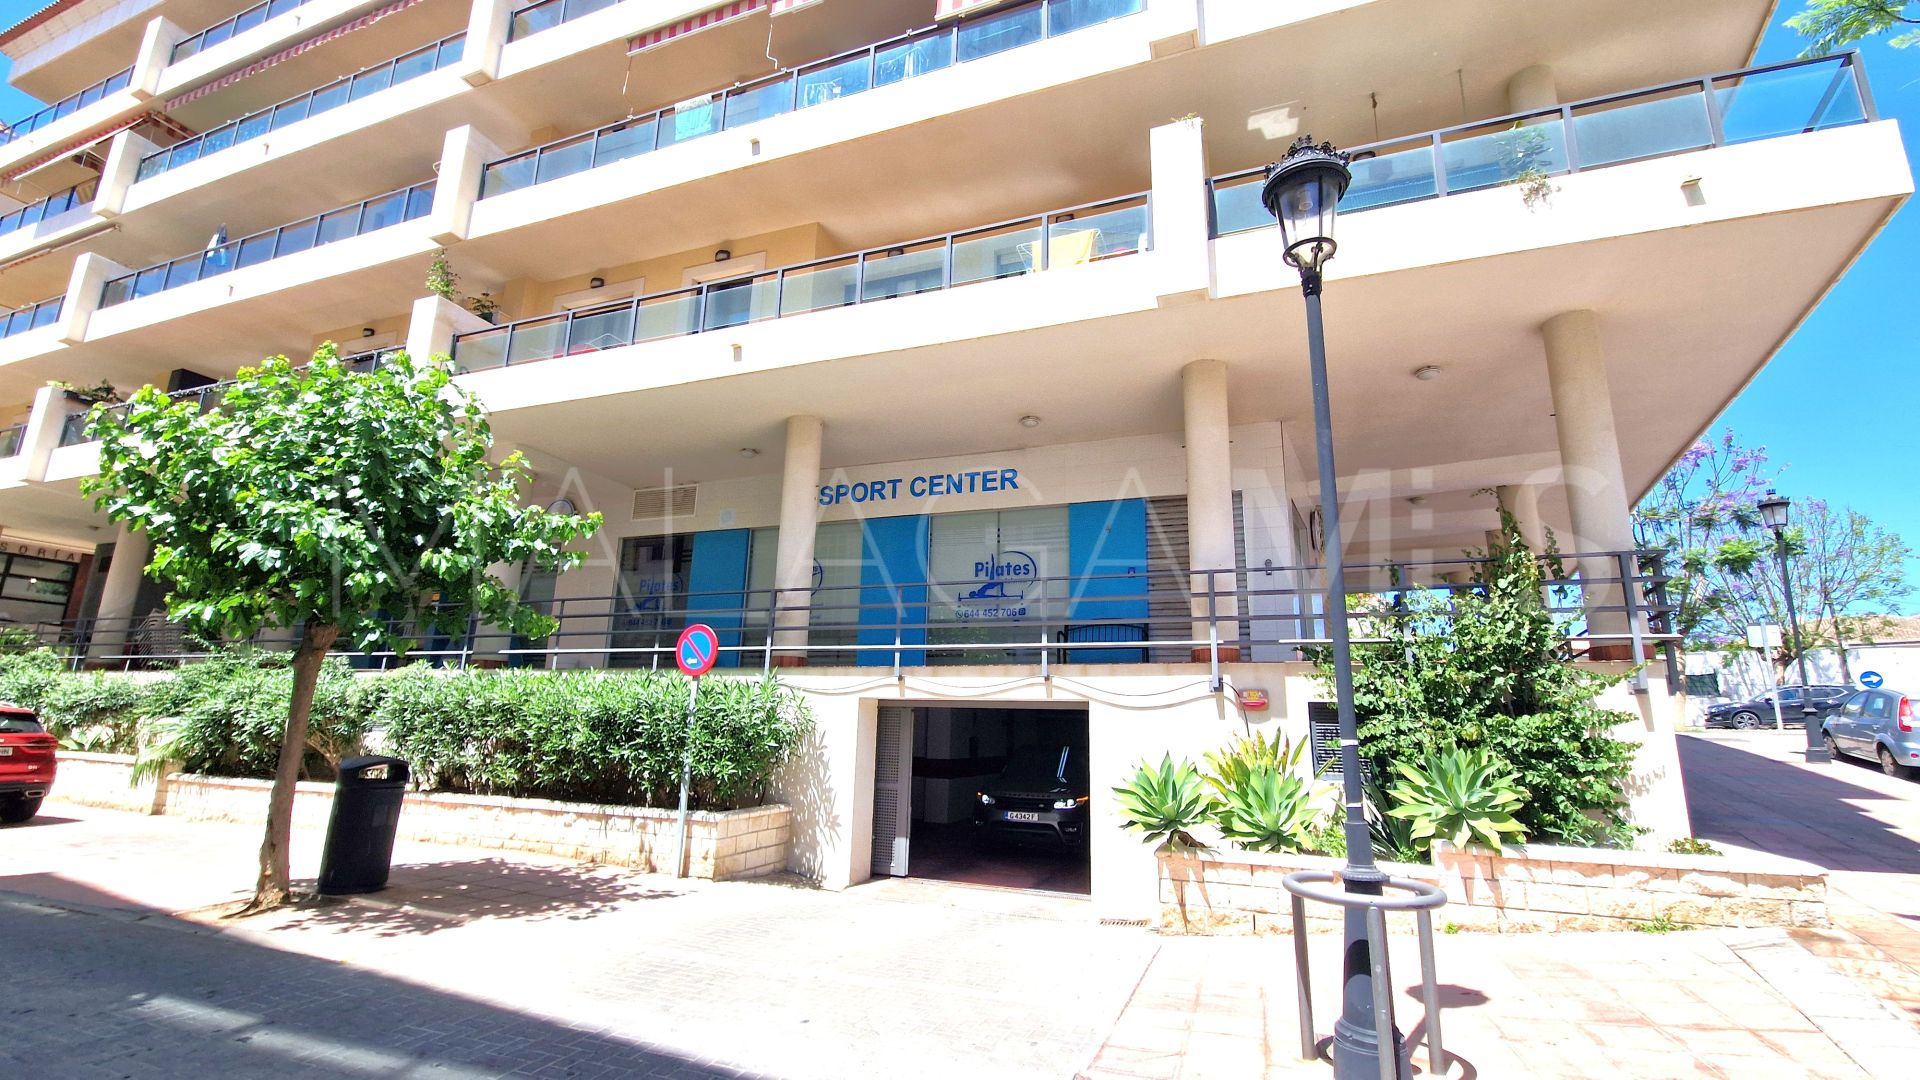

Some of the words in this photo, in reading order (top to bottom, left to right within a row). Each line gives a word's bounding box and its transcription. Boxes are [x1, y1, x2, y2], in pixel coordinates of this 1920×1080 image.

[819, 479, 902, 505] SPORT
[909, 468, 1019, 497] CENTER
[974, 557, 1030, 579] Pilates
[964, 610, 979, 618] 644
[982, 608, 998, 617] 452
[1001, 608, 1017, 616] 706
